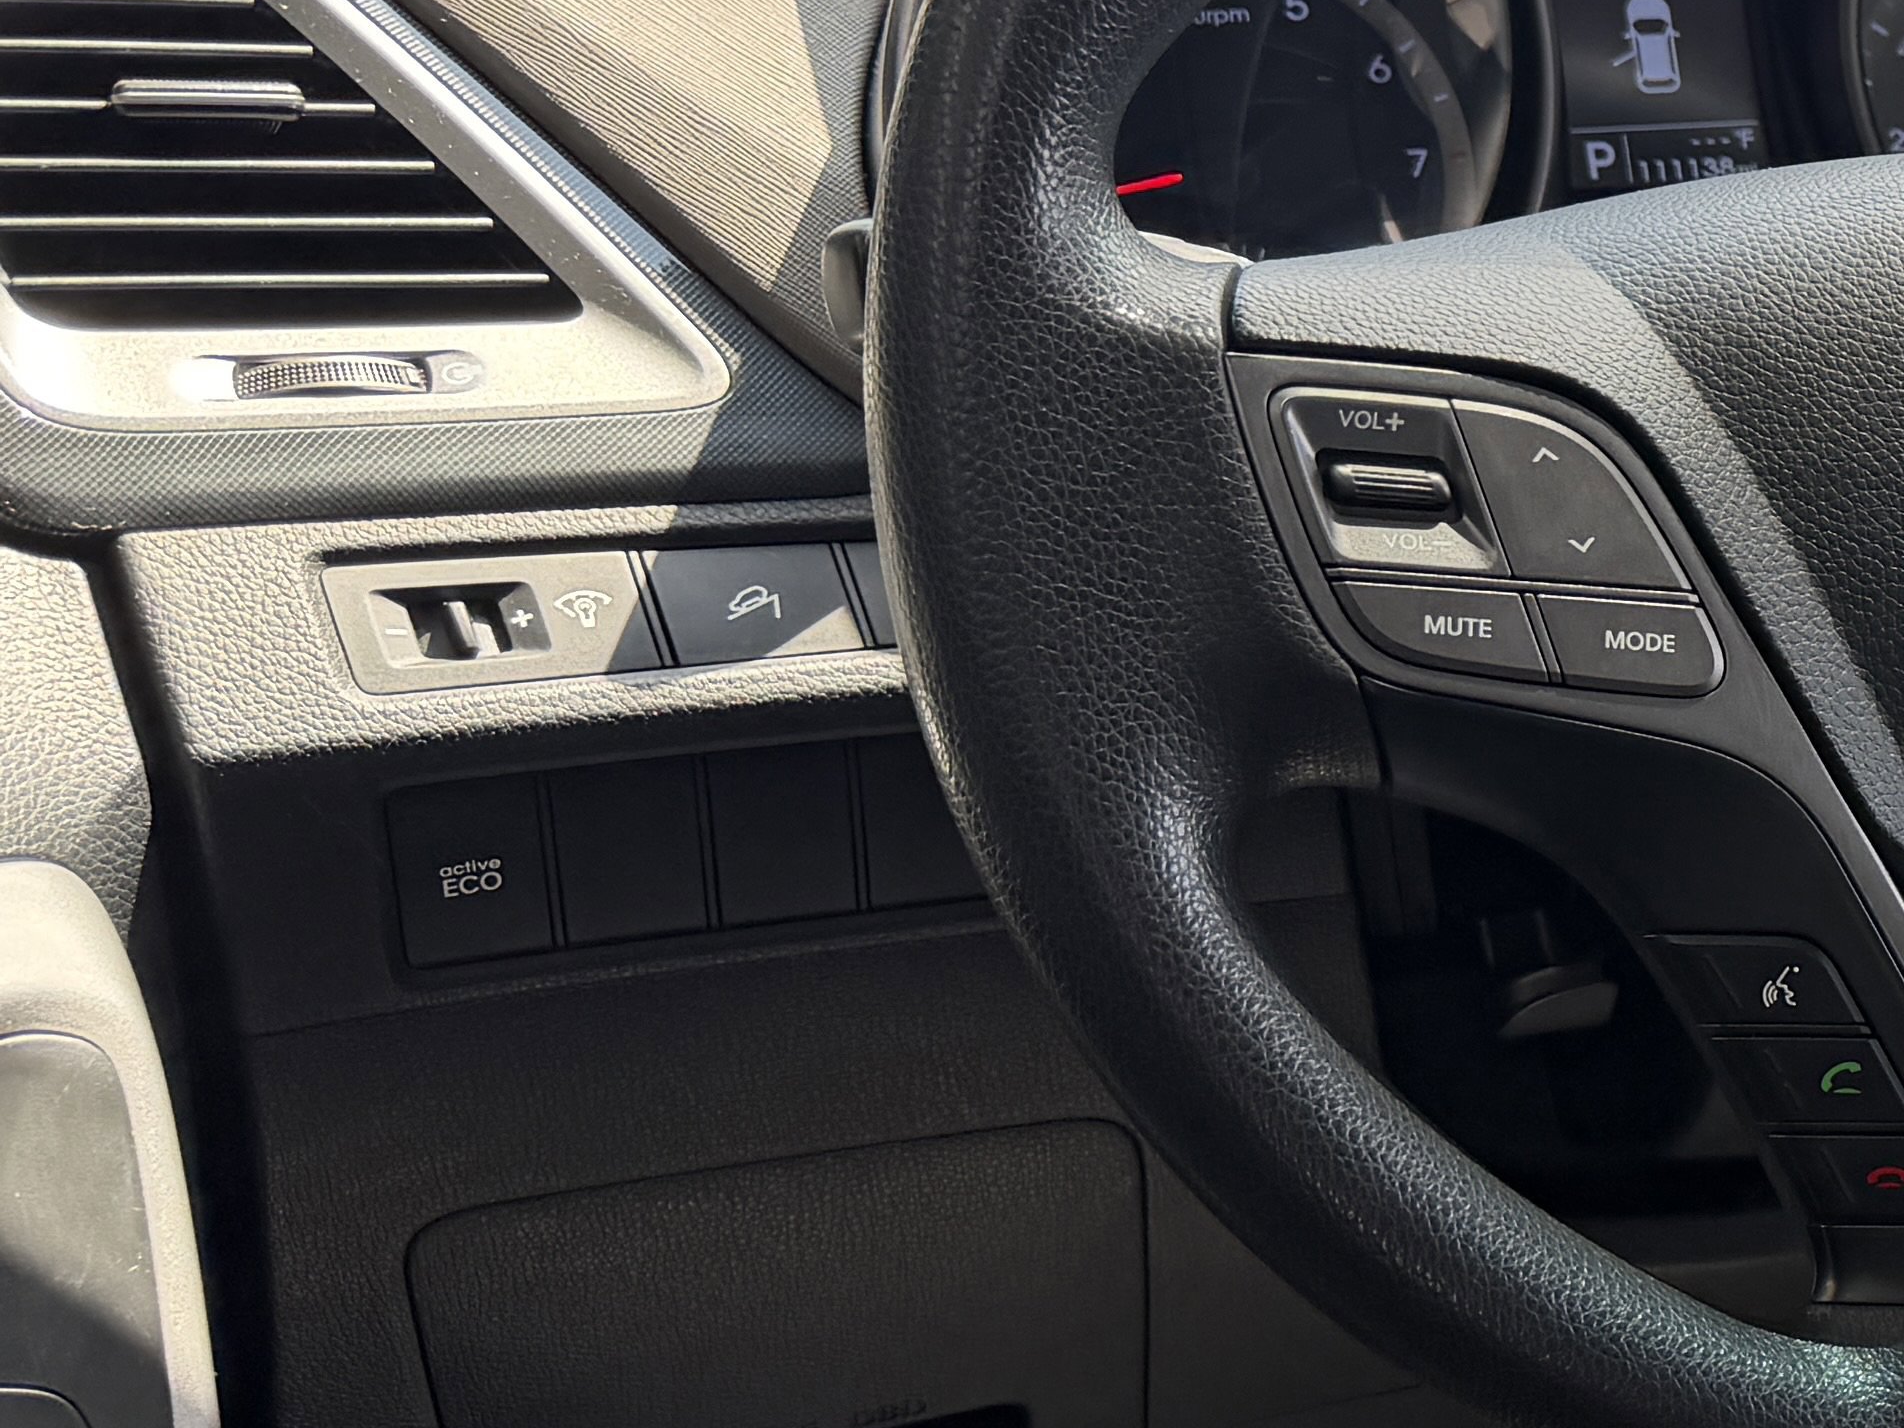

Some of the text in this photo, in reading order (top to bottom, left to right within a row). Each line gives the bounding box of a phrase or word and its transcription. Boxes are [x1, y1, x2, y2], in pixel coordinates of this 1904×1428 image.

[1368, 55, 1392, 84] 6
[1406, 147, 1428, 178] 7
[1585, 141, 1617, 181] P
[1339, 409, 1405, 432] VOL+
[1424, 614, 1493, 639] MUTE
[1604, 630, 1676, 654] MODE
[439, 858, 502, 878] active
[442, 871, 503, 898] ECO
